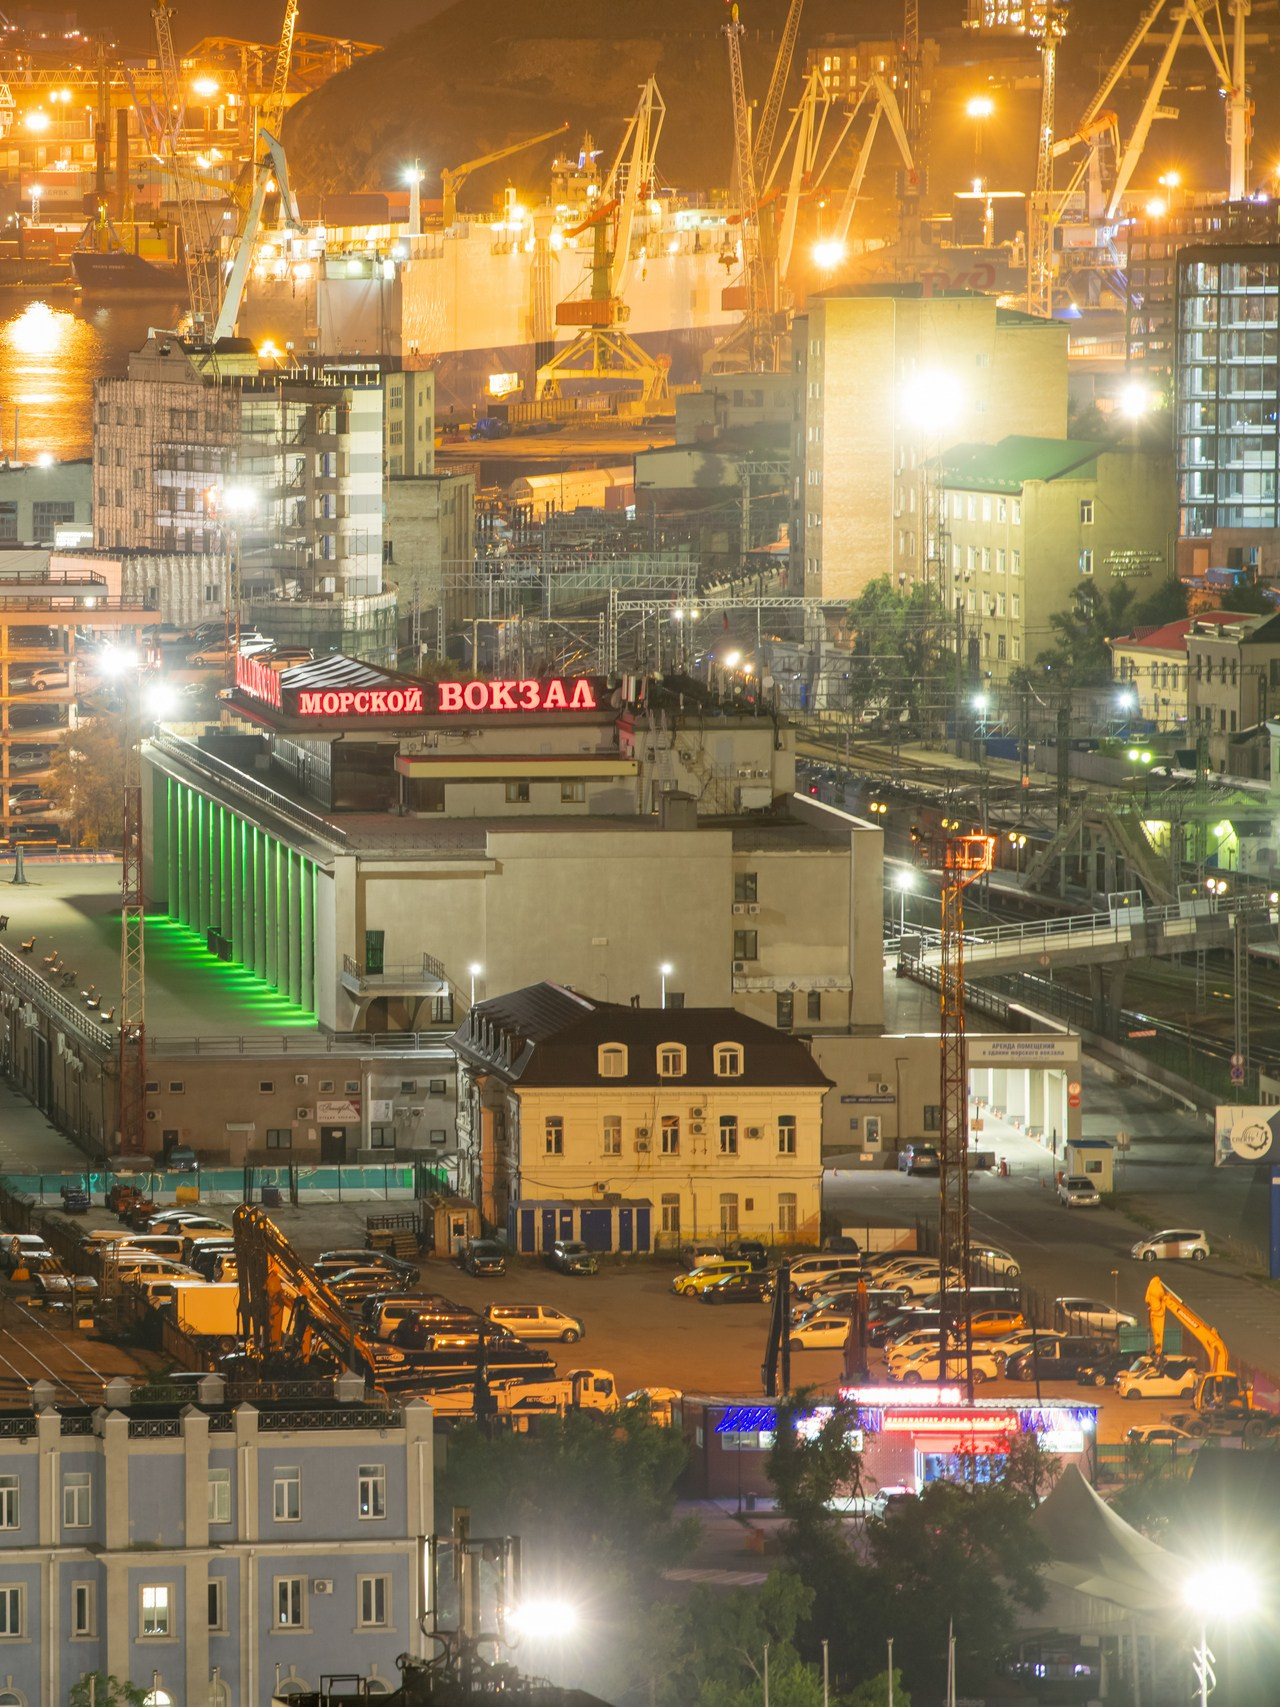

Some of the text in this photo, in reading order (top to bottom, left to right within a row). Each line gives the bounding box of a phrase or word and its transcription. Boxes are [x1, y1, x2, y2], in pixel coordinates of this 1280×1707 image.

[299, 679, 596, 714] МОРСКОЙ ВОКЗАЛ
[297, 1269, 319, 1294] HYUNDAI
